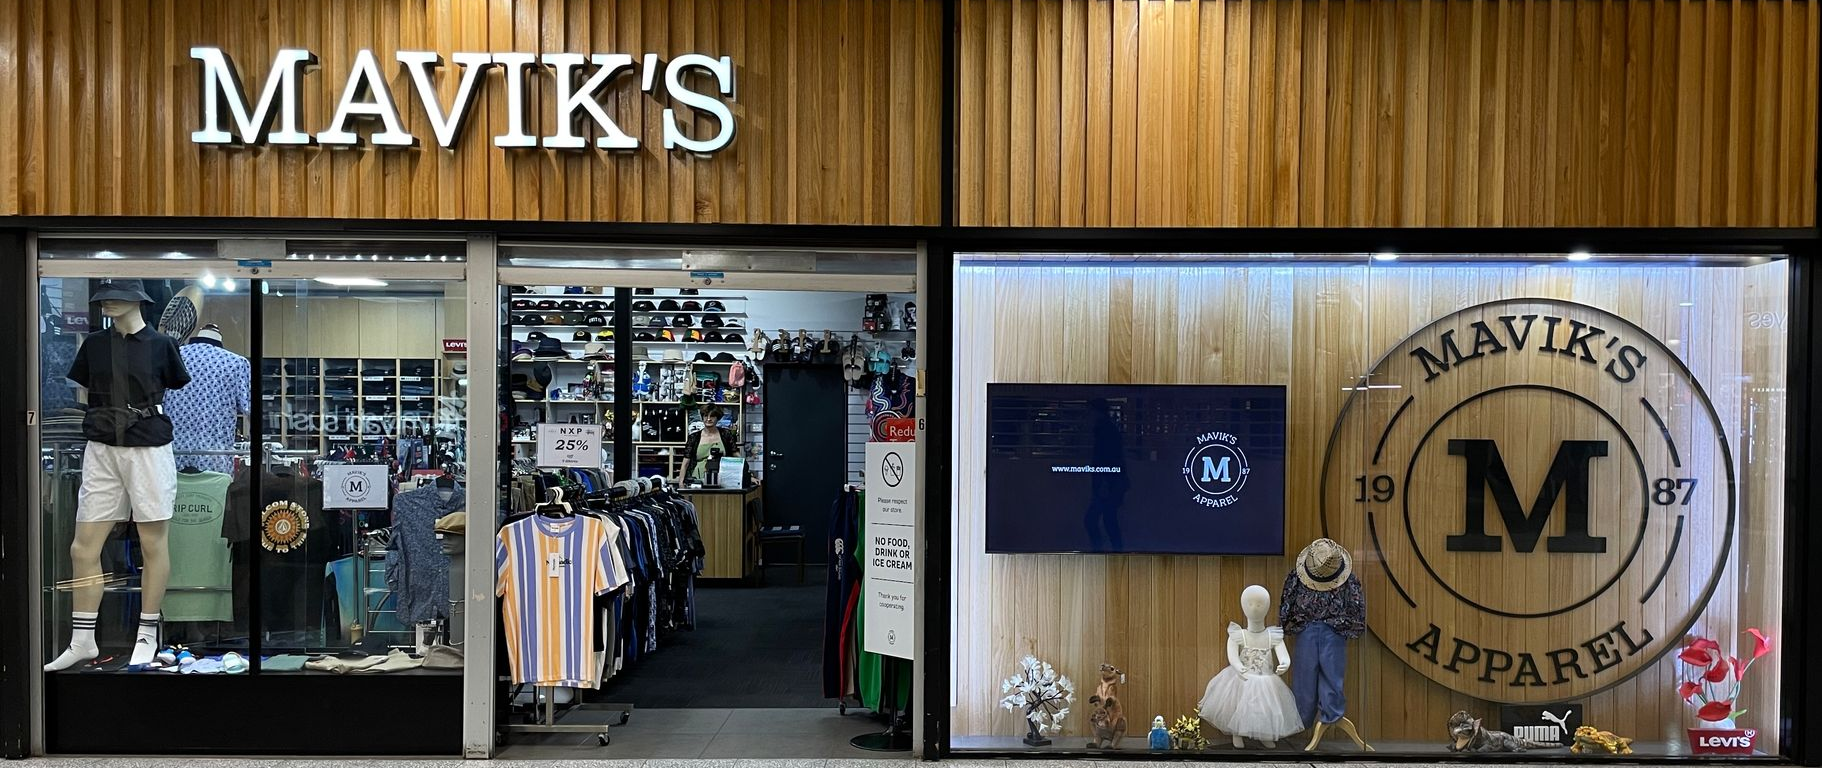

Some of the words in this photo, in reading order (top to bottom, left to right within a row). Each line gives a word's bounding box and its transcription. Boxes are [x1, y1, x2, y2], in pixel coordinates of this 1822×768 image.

[190, 47, 734, 152] MAVIK'S
[1410, 315, 1648, 383] MAVIK'S
[28, 411, 35, 424] 7
[918, 418, 925, 430] 6
[555, 439, 589, 450] 25%
[1197, 431, 1237, 445] MAVIK'S
[1051, 465, 1121, 473] www.maviks.com.au
[1182, 467, 1190, 475] 19
[1200, 456, 1231, 482] M
[1241, 467, 1250, 475] 87
[349, 481, 363, 492] M
[1355, 475, 1395, 503] 19
[1652, 478, 1698, 506] 87
[1192, 493, 1239, 508] APPAREL
[1447, 439, 1608, 553] M
[188, 504, 213, 513] CURL
[875, 536, 886, 546] NO
[887, 538, 910, 549] FOOD,
[875, 547, 898, 558] DRINK
[899, 549, 910, 559] OR
[872, 558, 885, 568] ICE
[886, 559, 913, 570] CREAM
[878, 591, 890, 599] Thank
[1406, 620, 1654, 687] APPAREL
[1513, 725, 1560, 742] PUMA
